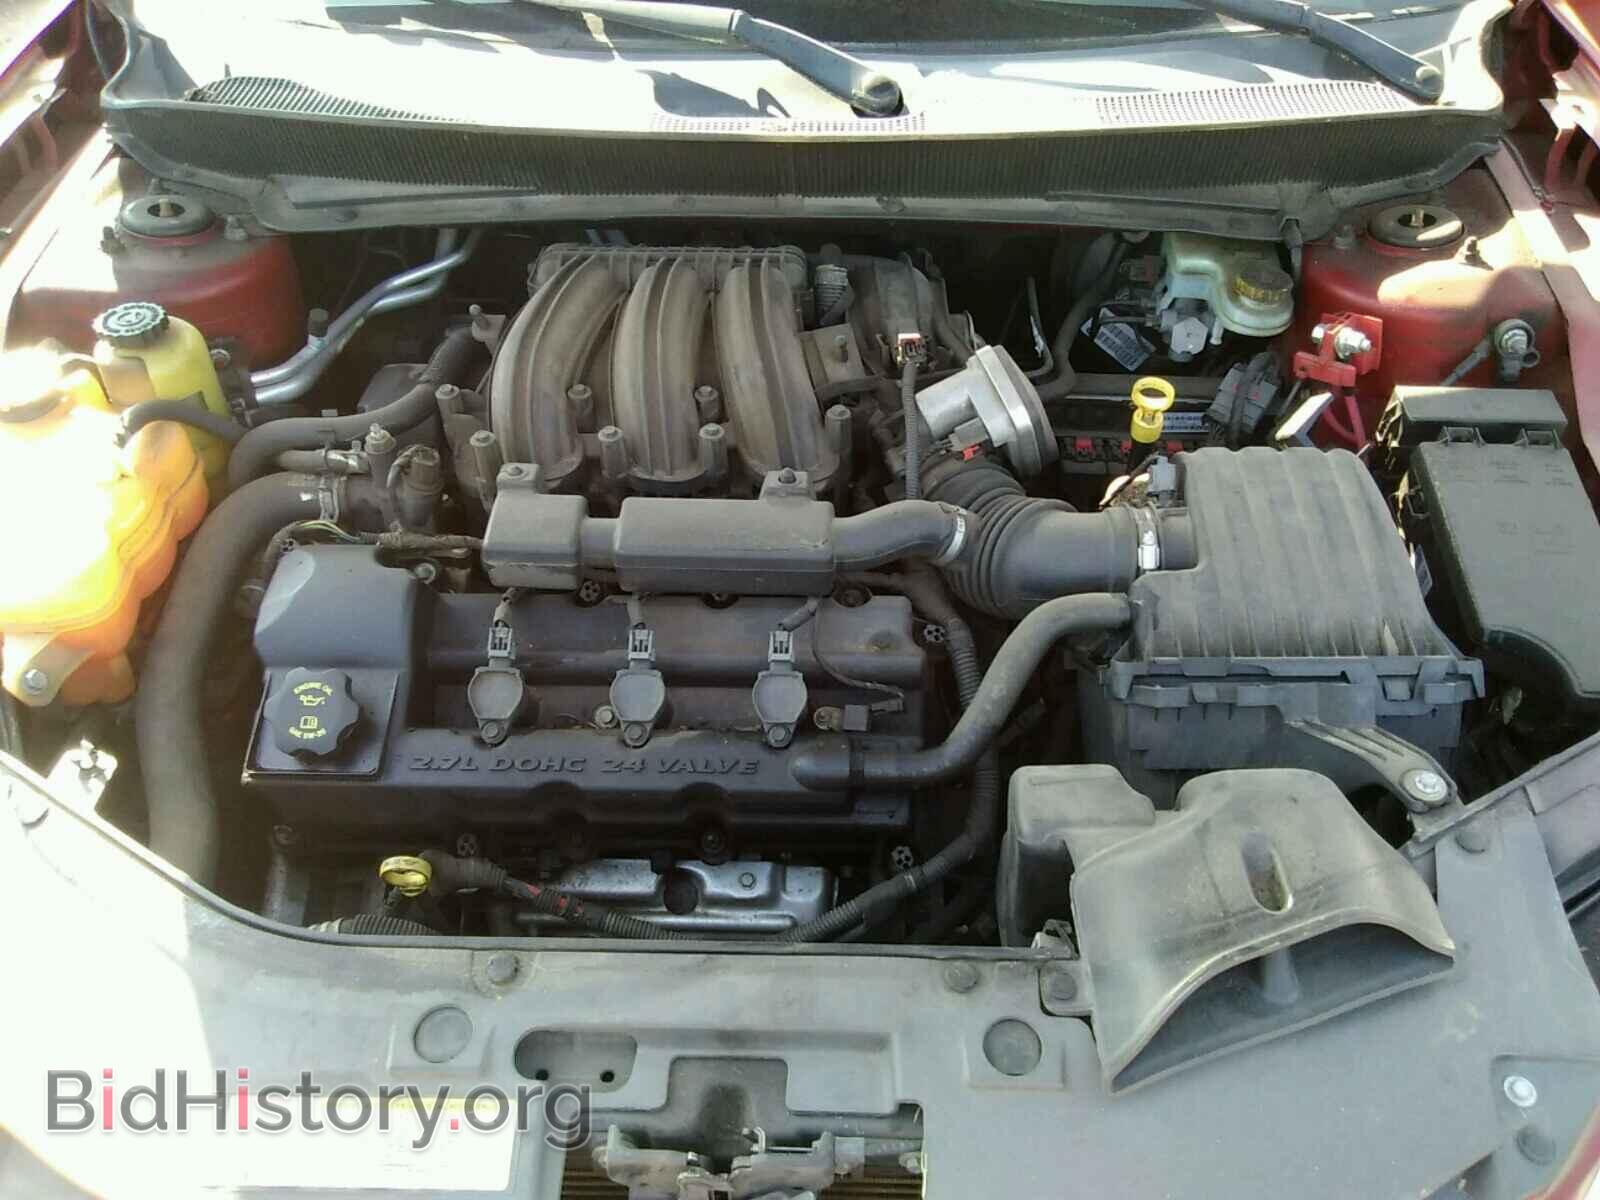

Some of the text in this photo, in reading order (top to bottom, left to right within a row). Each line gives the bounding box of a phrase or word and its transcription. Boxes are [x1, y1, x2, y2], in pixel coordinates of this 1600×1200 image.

[408, 756, 761, 775] 2.7L DOHC 24 VALVE
